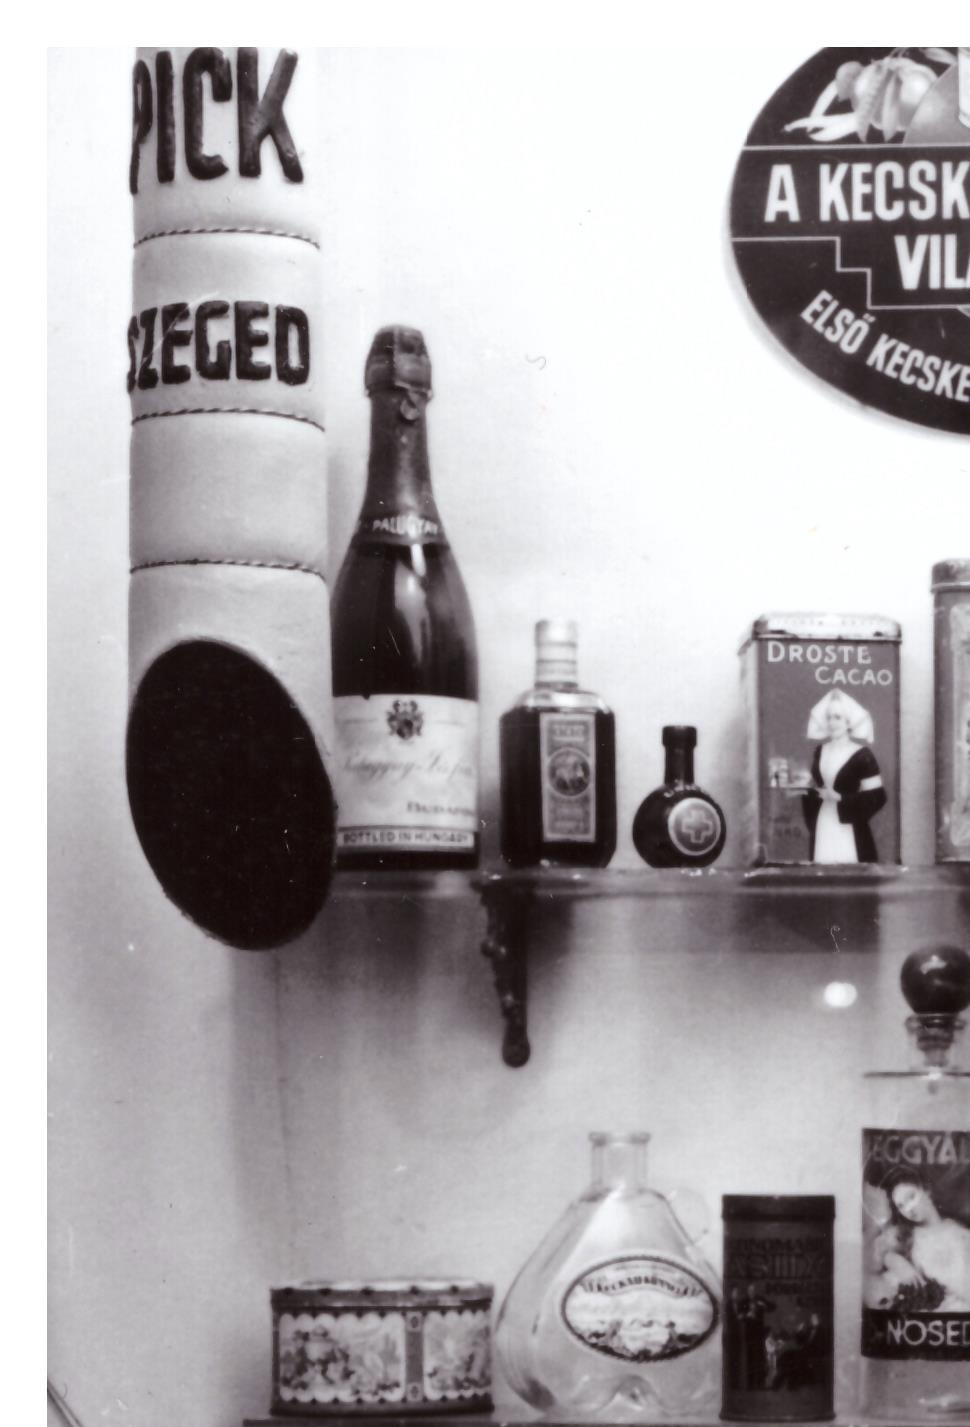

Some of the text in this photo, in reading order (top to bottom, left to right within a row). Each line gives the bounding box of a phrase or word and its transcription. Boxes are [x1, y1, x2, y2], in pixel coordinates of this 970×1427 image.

[129, 47, 304, 195] PICK
[764, 165, 800, 222] A
[801, 290, 875, 354] ELSŐ
[767, 641, 872, 664] DROSTE
[815, 667, 893, 686] CACAO
